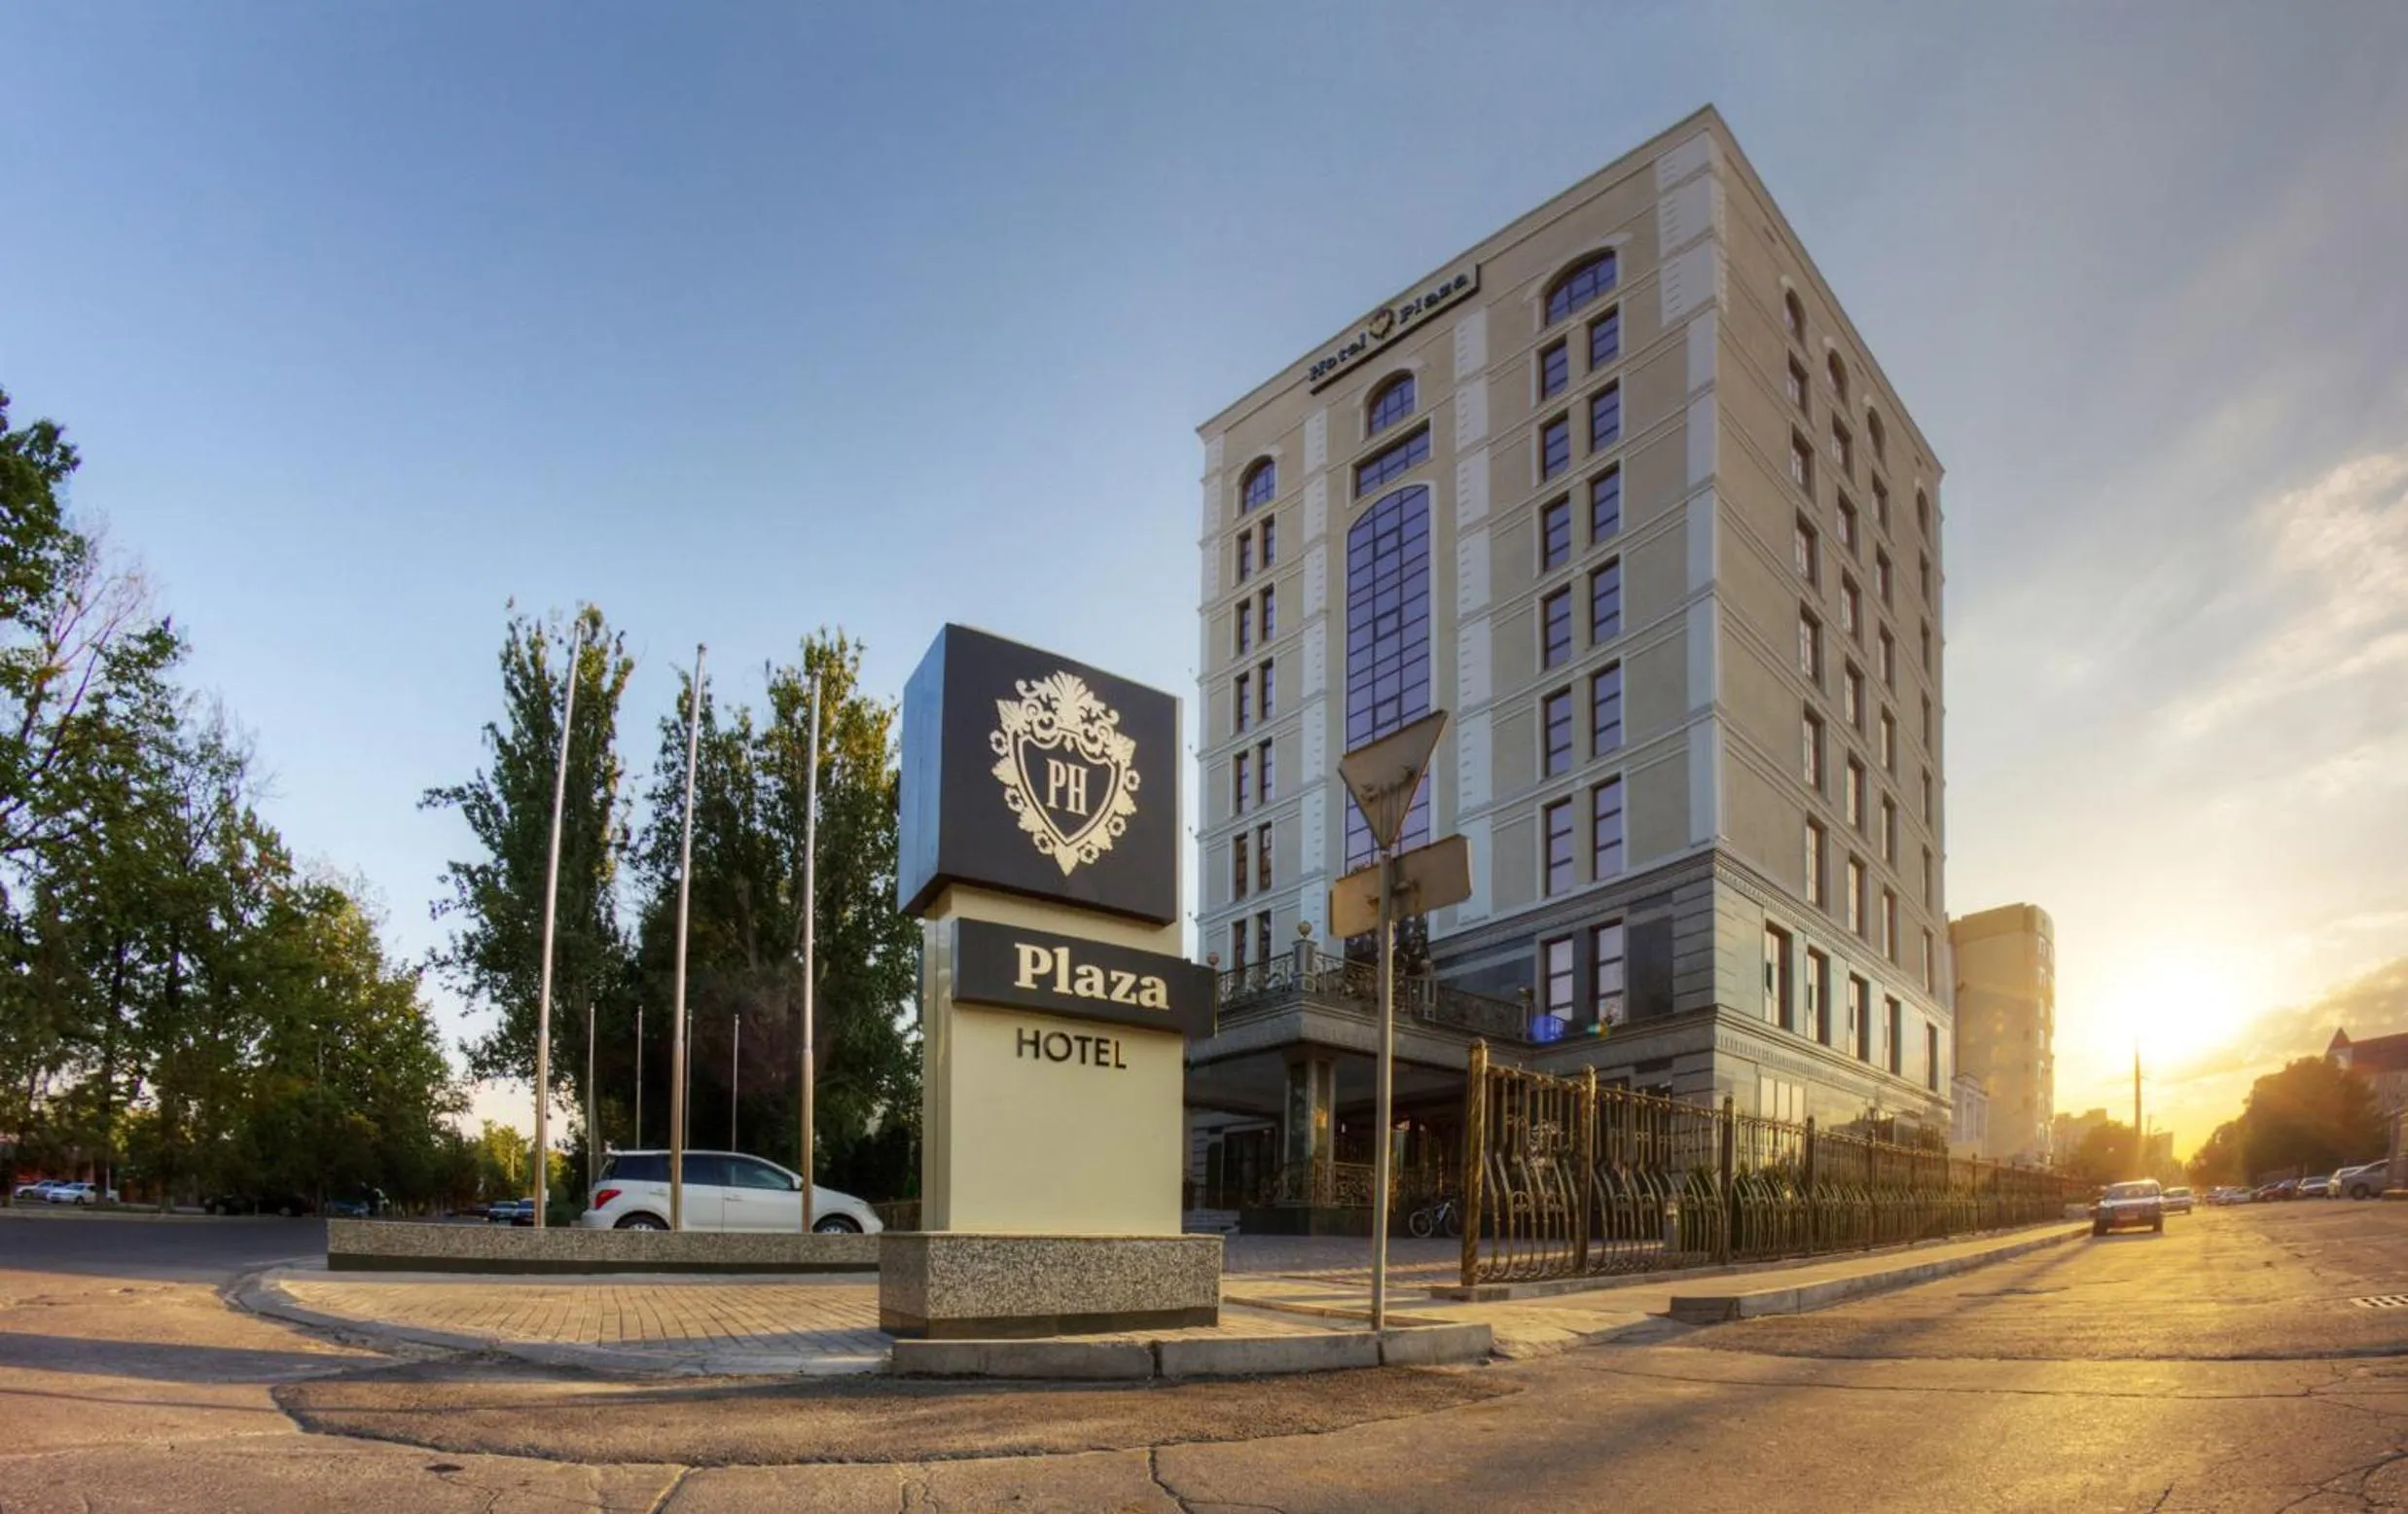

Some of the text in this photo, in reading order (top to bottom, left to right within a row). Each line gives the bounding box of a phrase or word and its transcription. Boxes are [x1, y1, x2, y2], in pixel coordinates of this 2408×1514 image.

[1309, 273, 1468, 381] Hotel Plaza
[1046, 757, 1088, 816] PH
[1014, 942, 1169, 1010] Plaza
[1017, 1027, 1127, 1069] HOTEL
